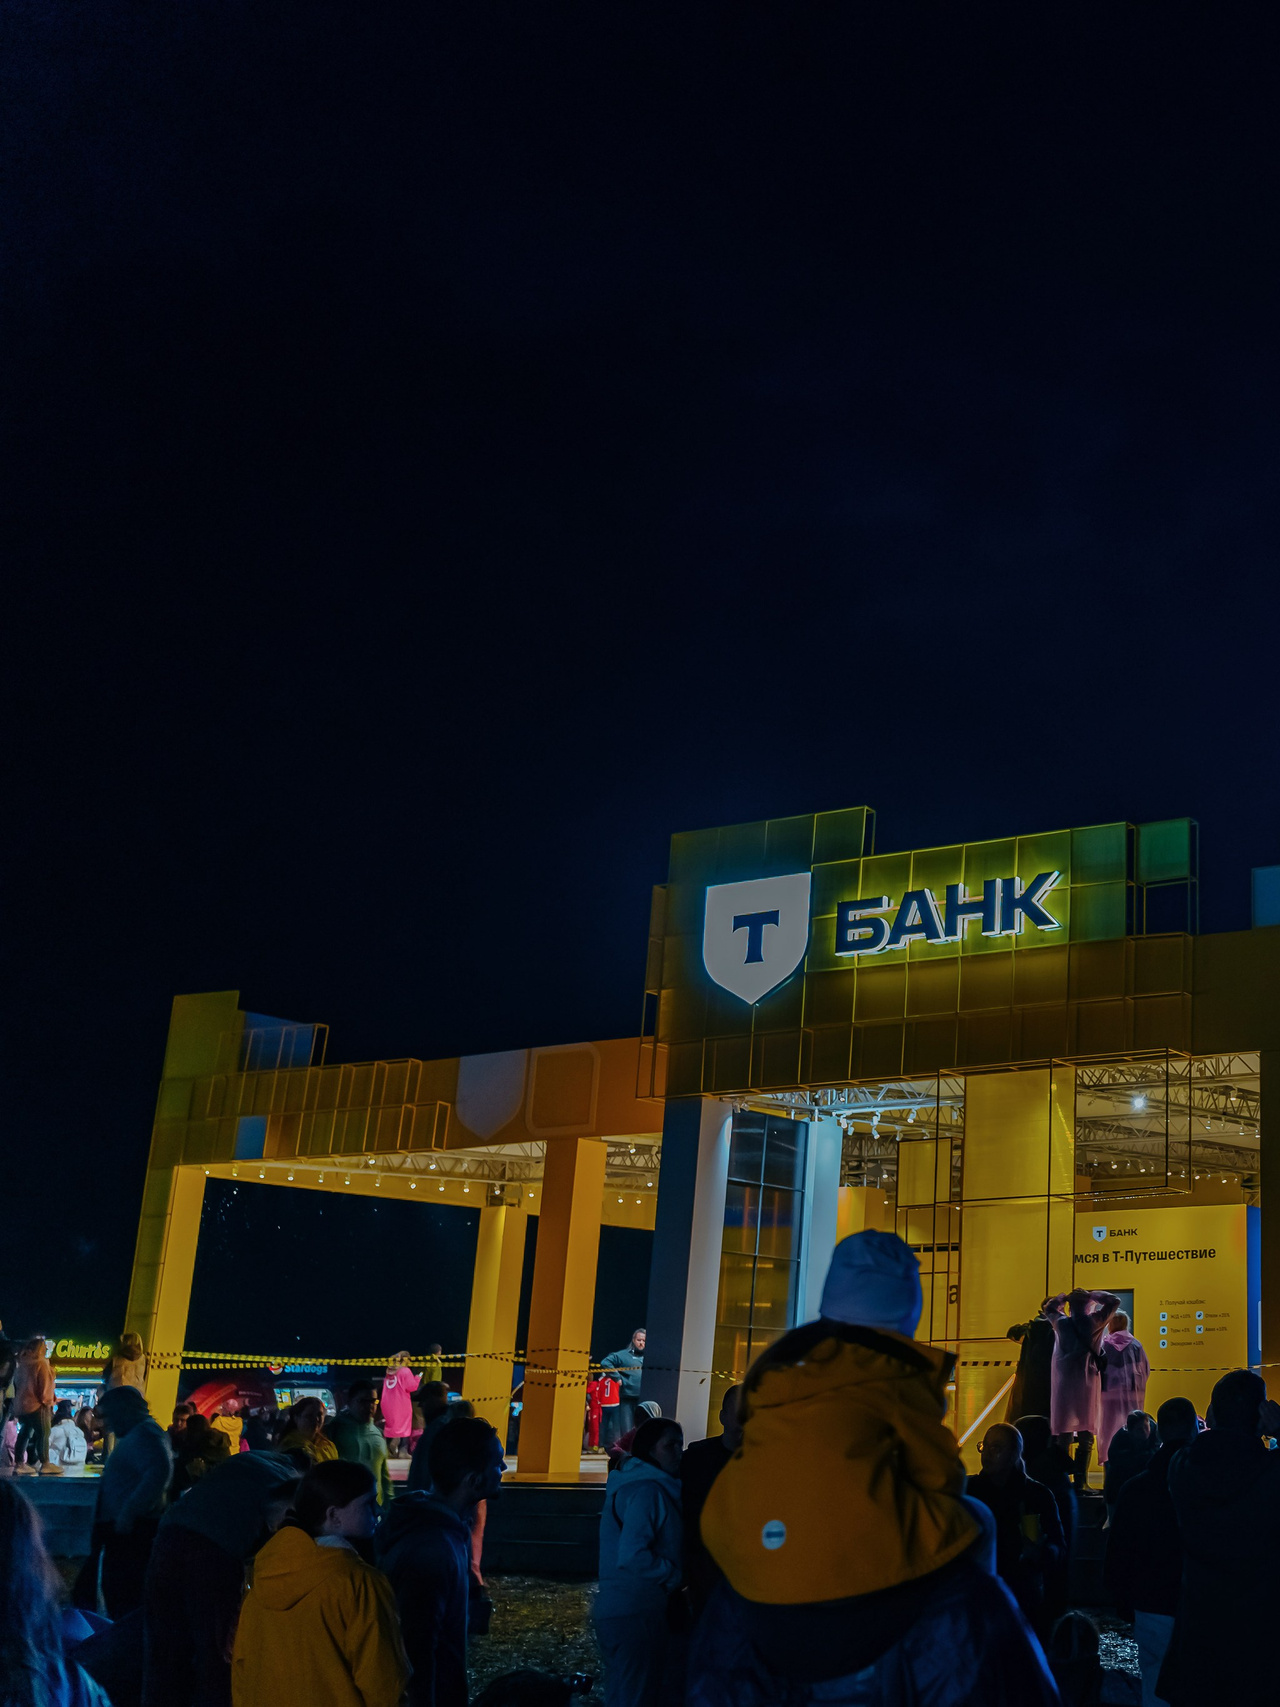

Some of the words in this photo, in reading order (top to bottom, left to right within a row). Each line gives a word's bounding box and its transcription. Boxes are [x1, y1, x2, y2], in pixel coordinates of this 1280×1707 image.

[834, 870, 1062, 957] БАНК
[1109, 1228, 1138, 1237] БАНК
[1102, 1254, 1109, 1262] в
[1113, 1248, 1216, 1264] Т-Путешествие
[56, 1339, 110, 1359] Churros
[284, 1362, 328, 1375] Stardogs
